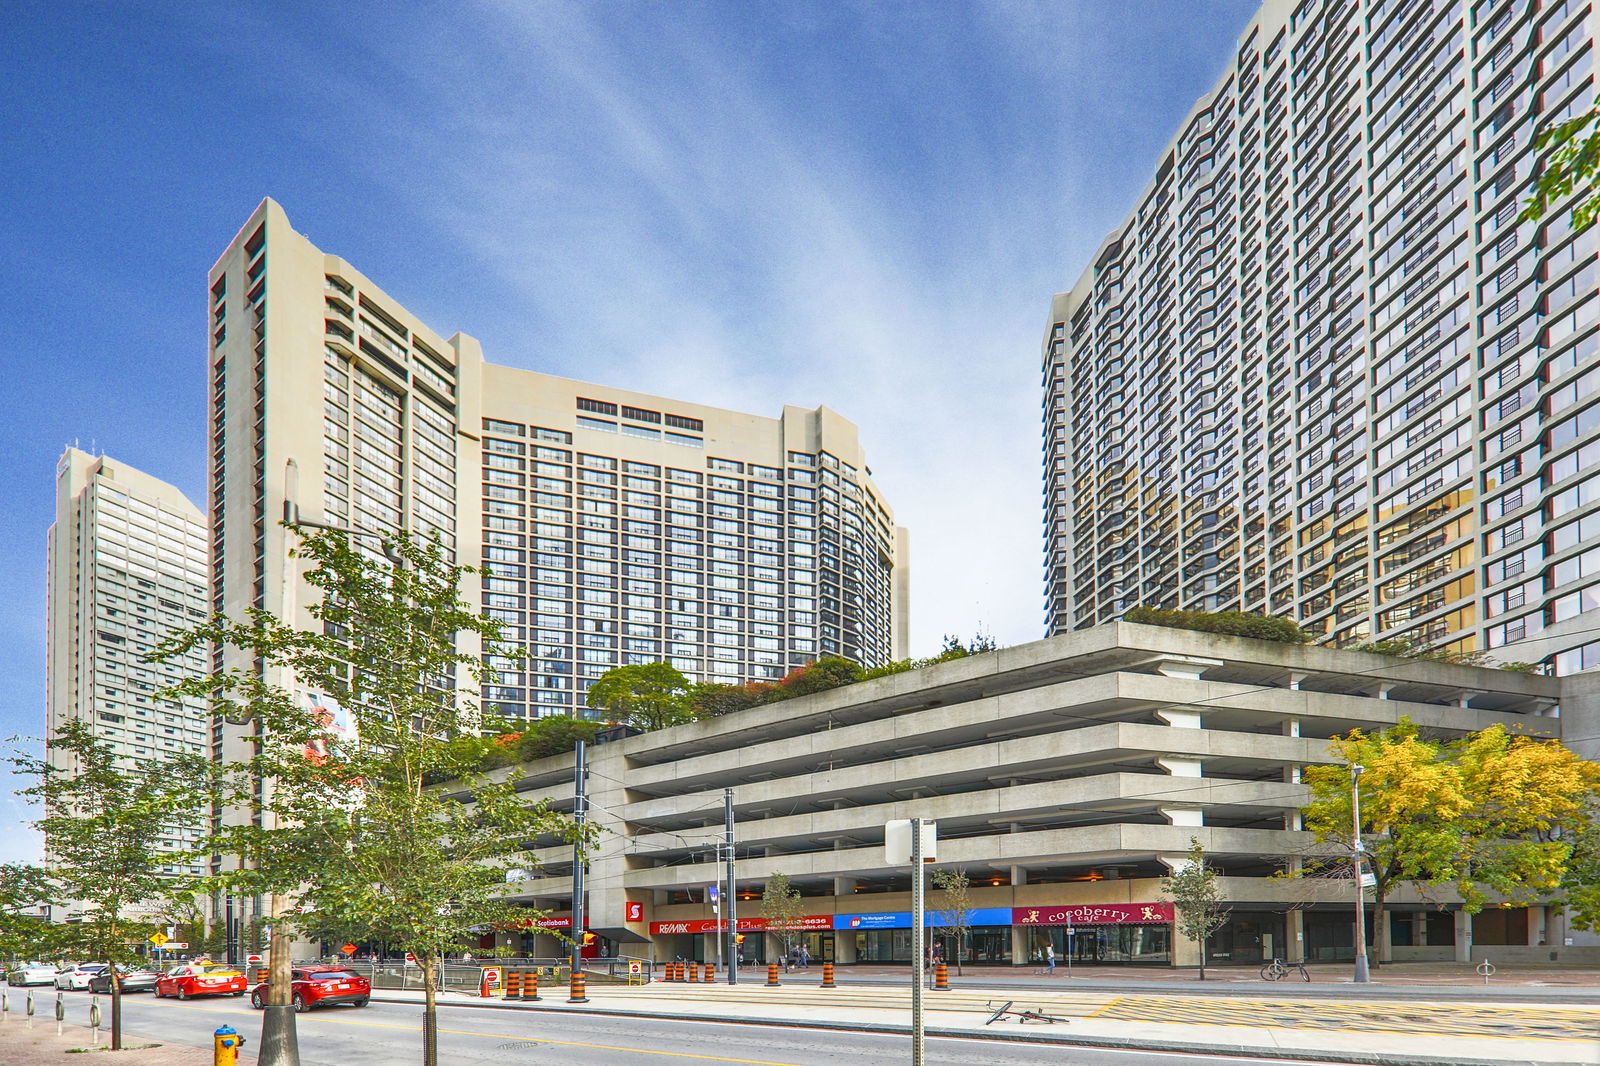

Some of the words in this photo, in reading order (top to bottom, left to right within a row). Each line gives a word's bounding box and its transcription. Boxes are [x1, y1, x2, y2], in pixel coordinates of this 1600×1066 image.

[1048, 906, 1130, 923] cocoberry
[537, 919, 570, 927] Scotiabank
[659, 923, 688, 934] RE/MAX
